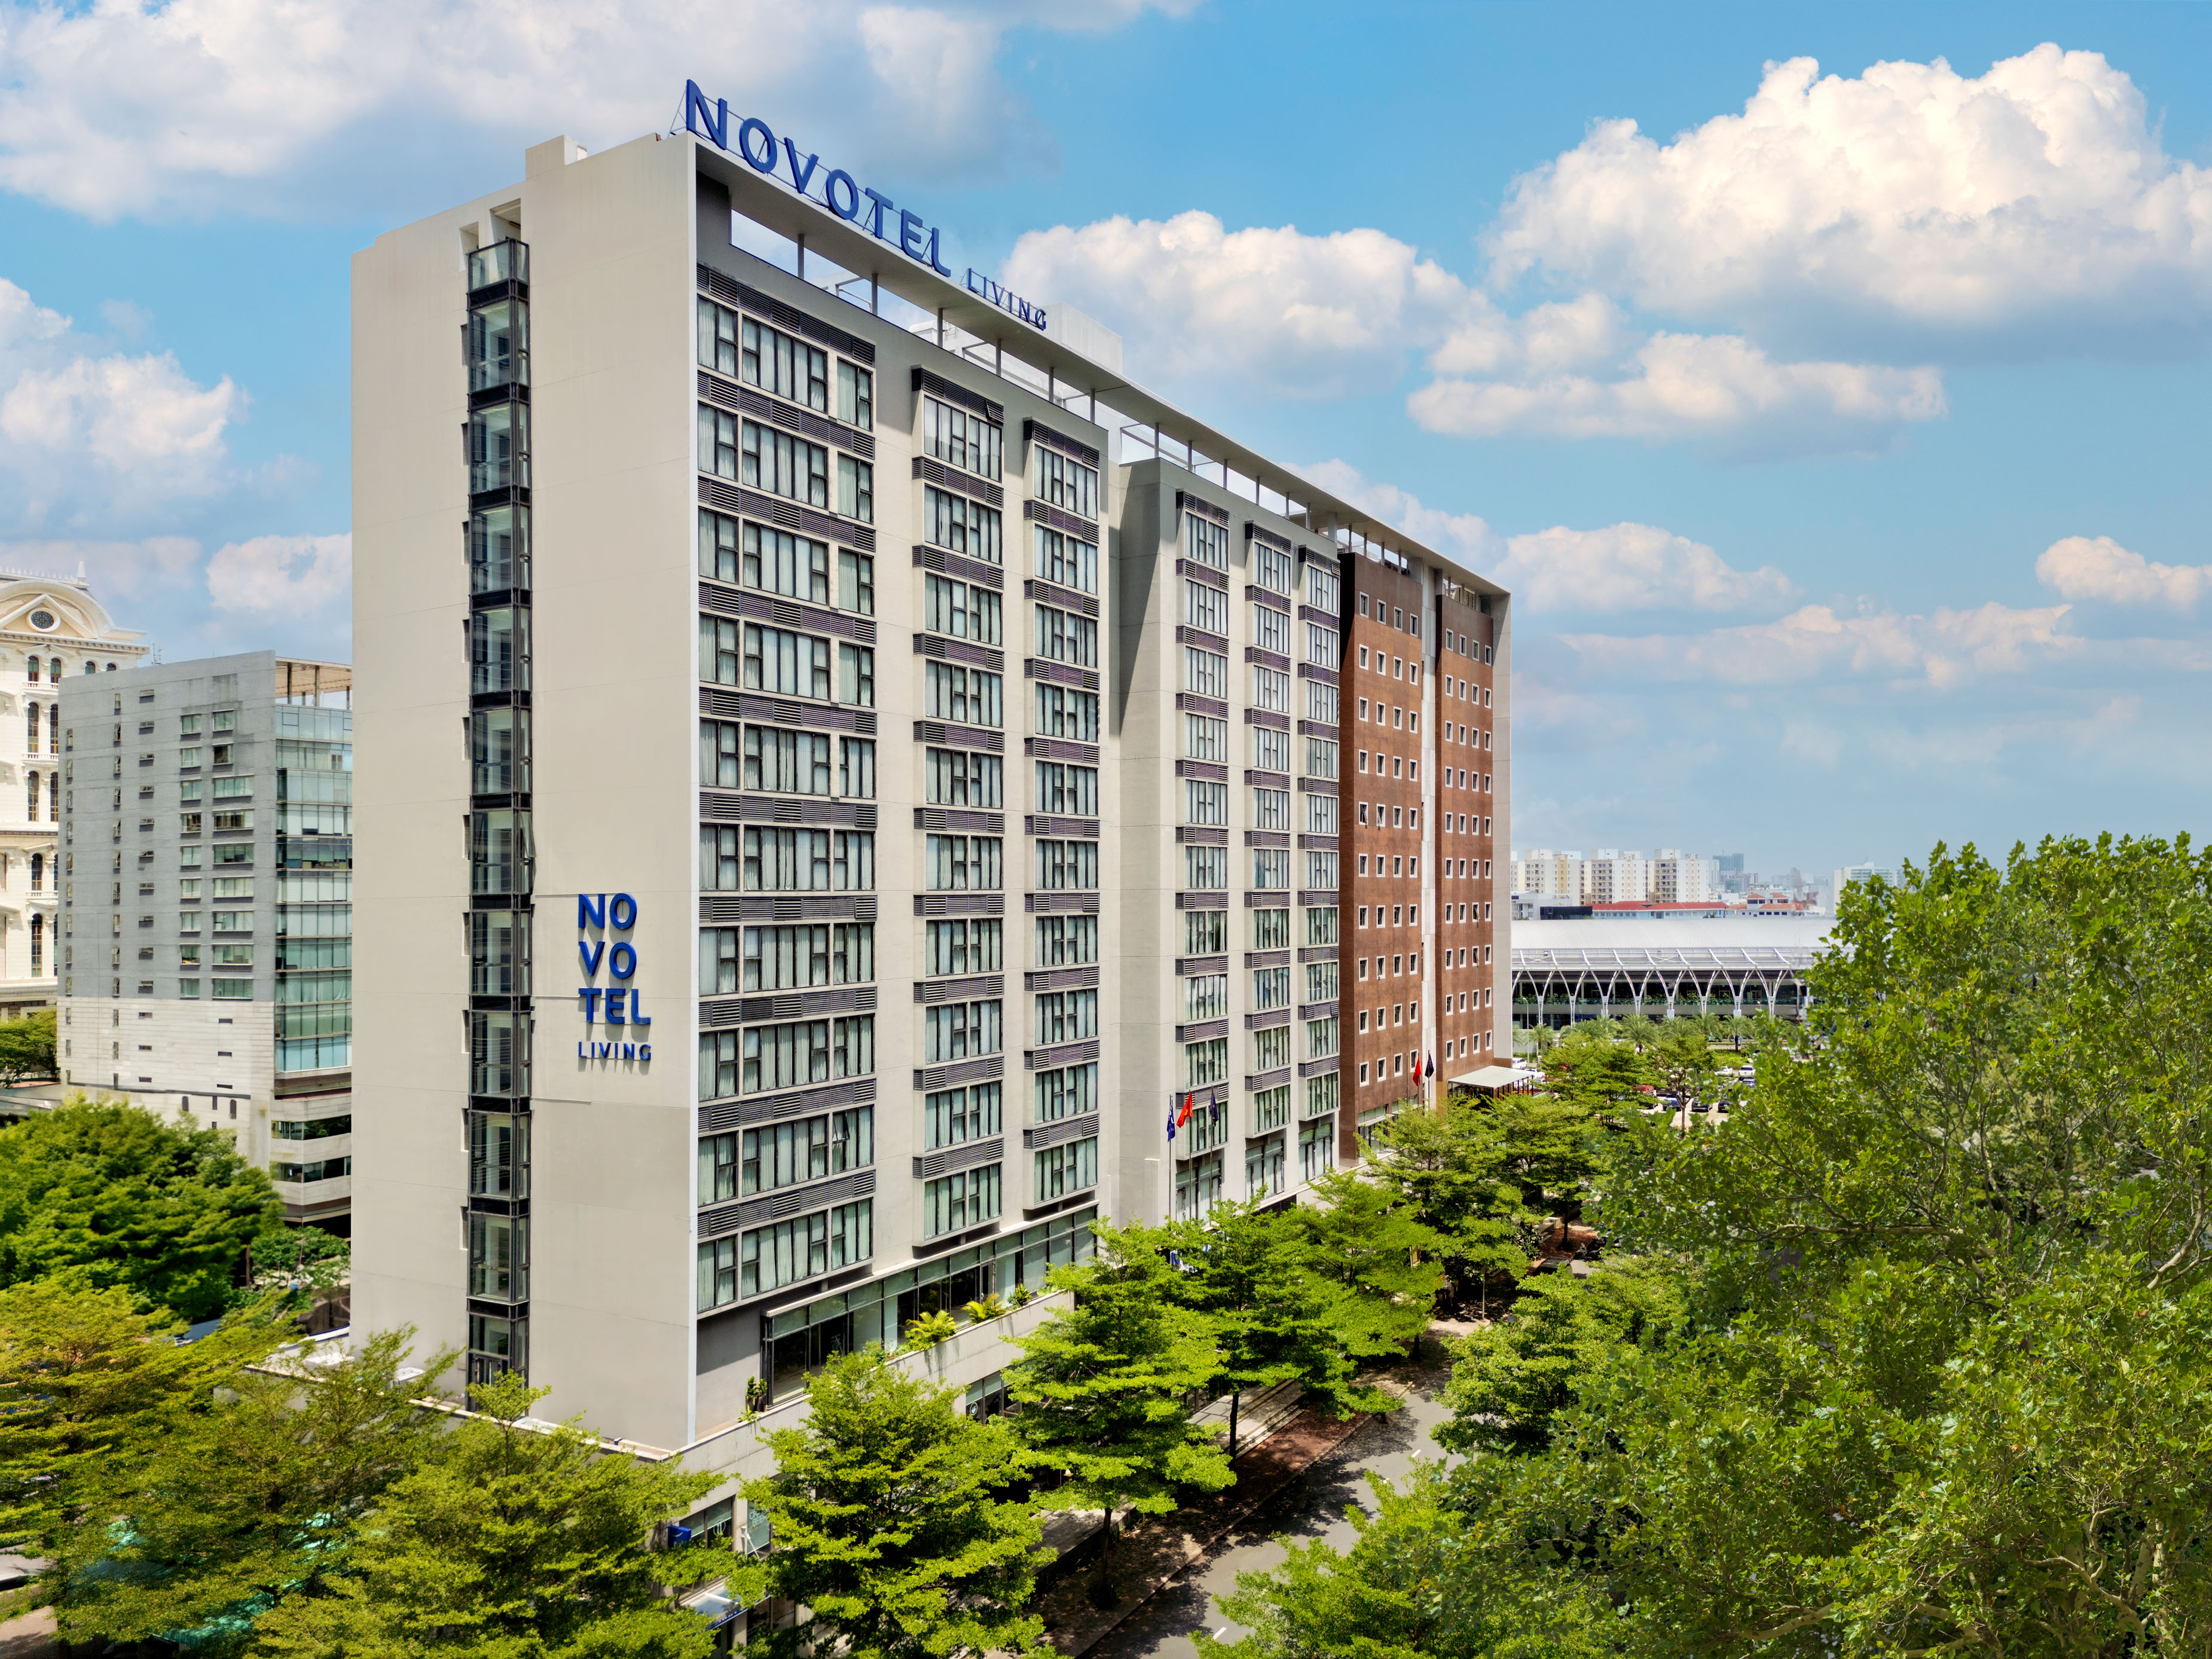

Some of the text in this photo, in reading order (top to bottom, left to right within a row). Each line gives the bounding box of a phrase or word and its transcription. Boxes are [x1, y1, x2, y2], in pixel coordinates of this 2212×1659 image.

[686, 79, 1046, 331] NOVOTEL LIVING
[578, 893, 637, 930] NO
[578, 941, 637, 979] VO
[578, 988, 651, 1025] TEL
[578, 1041, 651, 1061] LIVING
